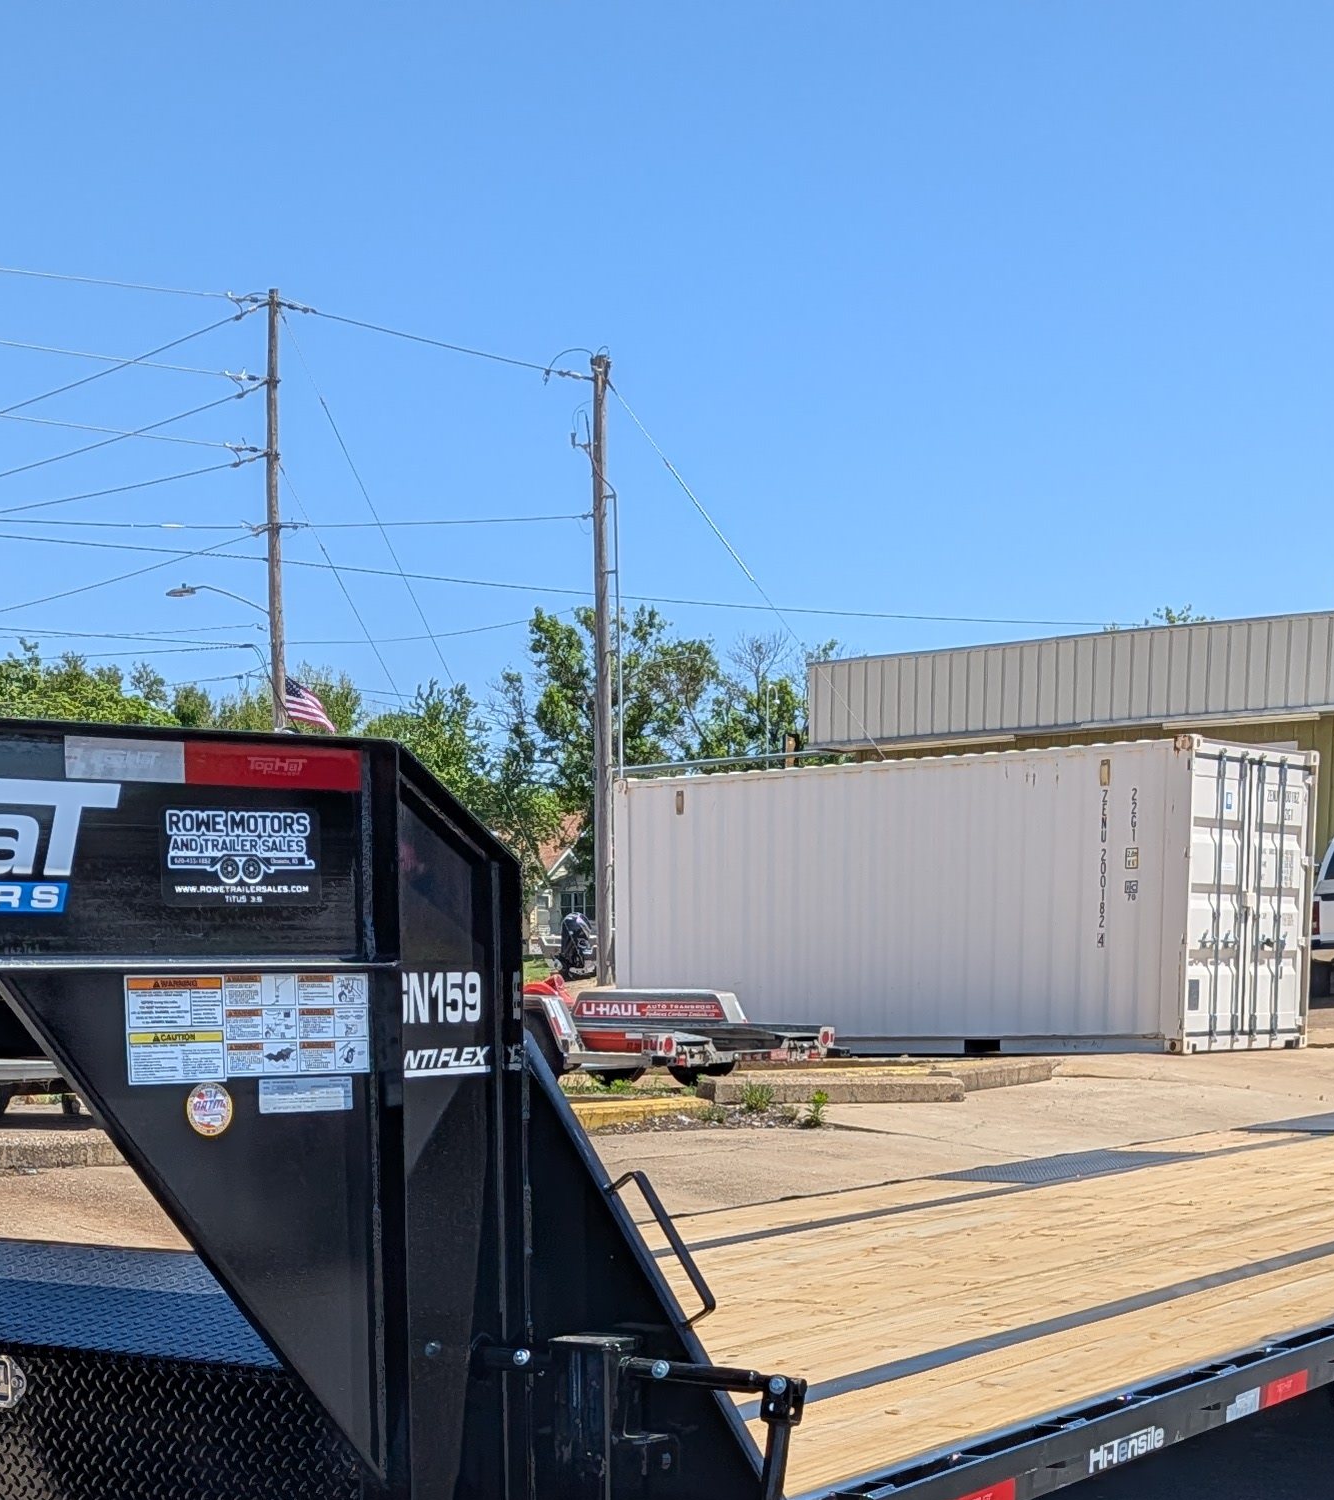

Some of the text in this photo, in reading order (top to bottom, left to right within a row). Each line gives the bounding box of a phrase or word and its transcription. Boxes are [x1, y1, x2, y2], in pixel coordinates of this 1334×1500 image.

[166, 810, 311, 836] ROWE MOTORS
[170, 836, 307, 854] AND TRAILER SALES
[1097, 789, 1108, 948] ZENU 200182 4
[174, 885, 309, 894] WWW.ROWETRAILERSALES.COM
[225, 895, 247, 903] TITUS
[161, 980, 198, 988] WARNING
[582, 1002, 641, 1016] U-HAUL
[161, 1033, 196, 1041] CAUTION
[1089, 1425, 1165, 1474] Hi-Tensile
